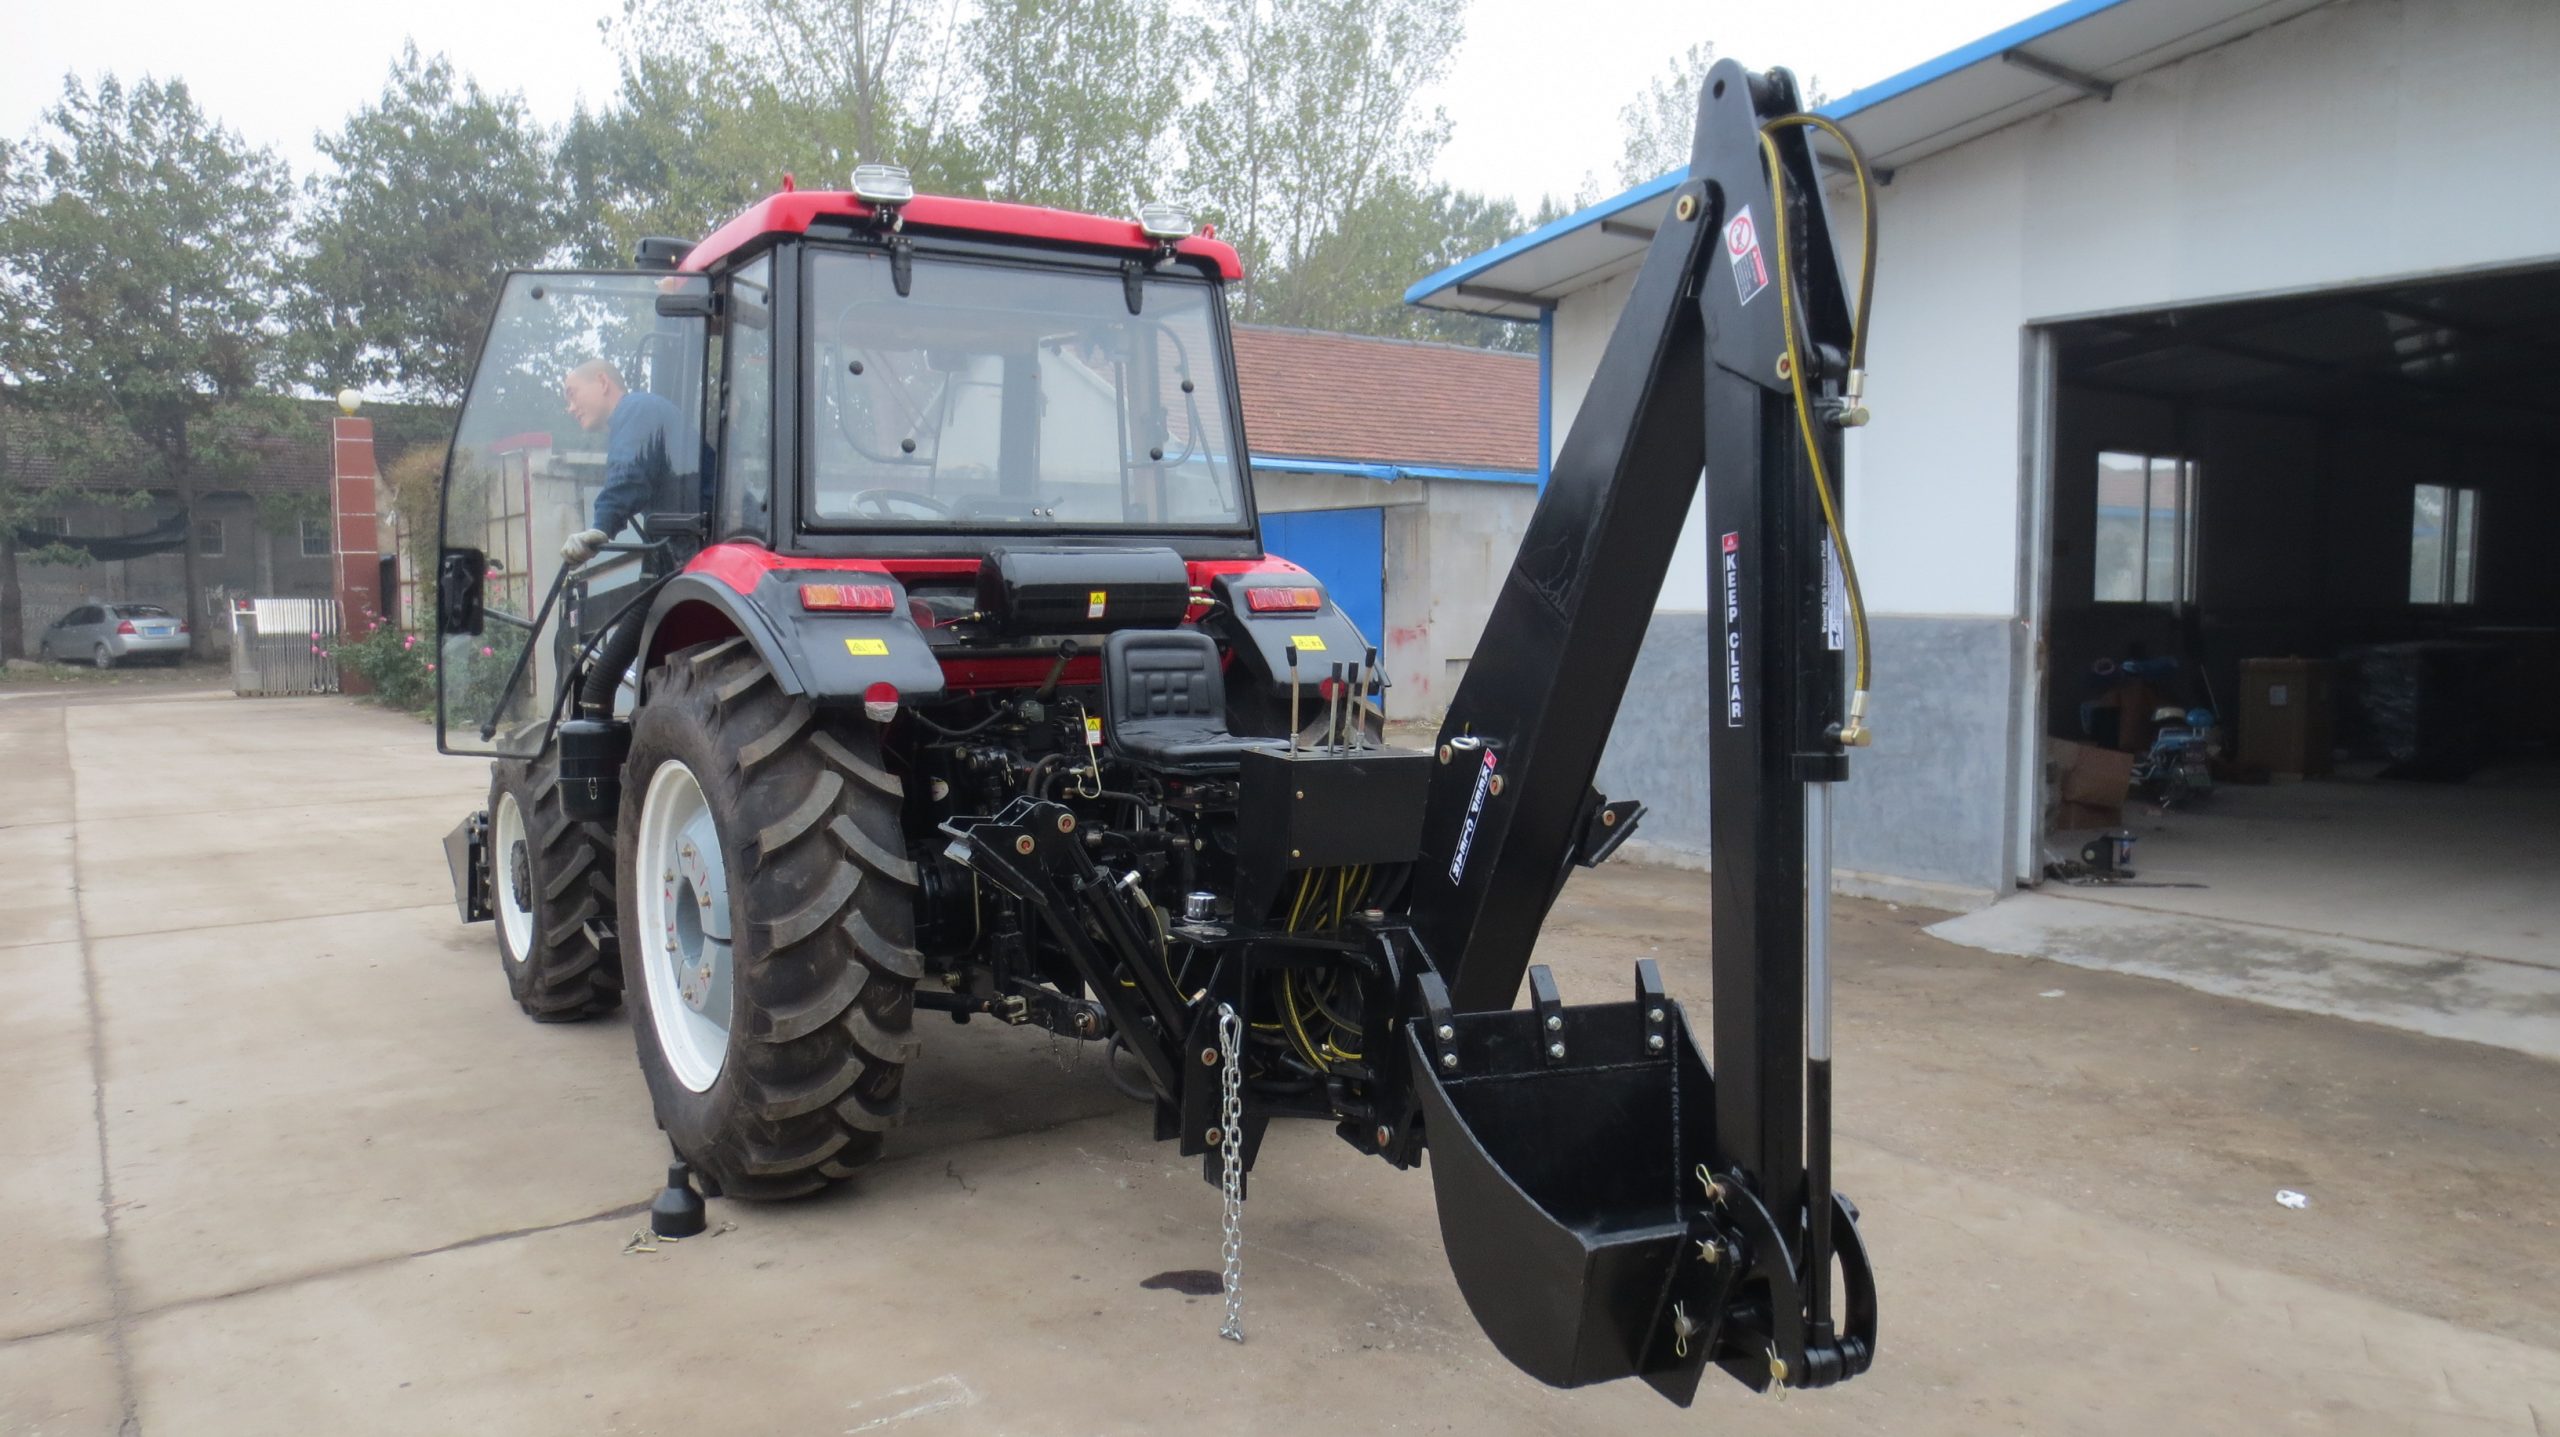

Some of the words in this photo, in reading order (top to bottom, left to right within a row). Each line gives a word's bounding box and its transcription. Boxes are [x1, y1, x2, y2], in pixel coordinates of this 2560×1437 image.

[1726, 554, 1738, 623] KEEP
[1729, 632, 1742, 718] CLEAR
[1471, 765, 1490, 812] KEEP
[1452, 818, 1473, 878] CLEAR
